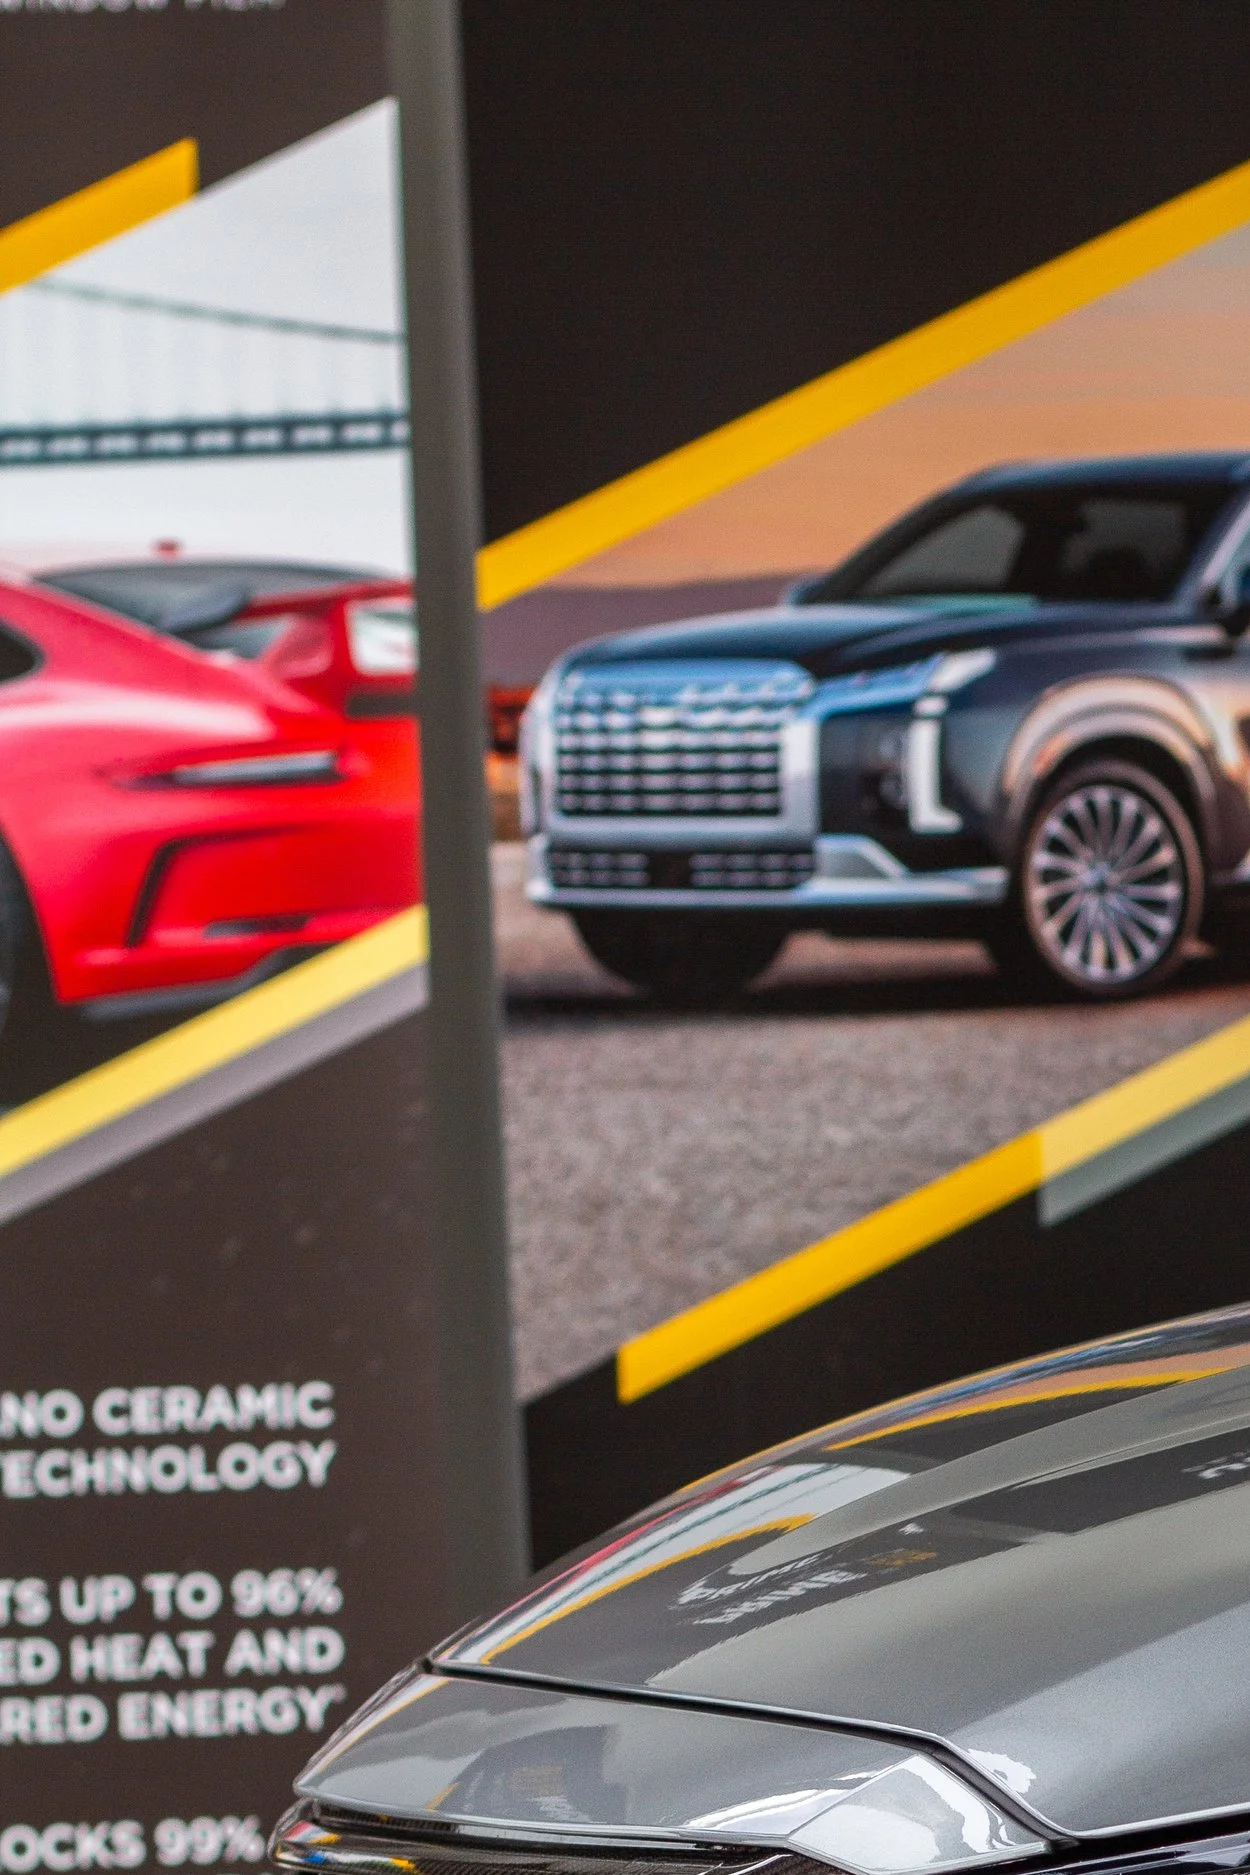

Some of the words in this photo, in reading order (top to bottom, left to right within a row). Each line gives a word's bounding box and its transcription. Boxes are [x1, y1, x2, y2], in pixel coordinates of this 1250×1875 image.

[92, 1380, 335, 1436] CERAMIC
[0, 1439, 337, 1498] ECHNOLOGY
[59, 1574, 136, 1624] UP
[142, 1570, 222, 1621] TO
[231, 1567, 343, 1618] 96%
[69, 1630, 215, 1683] HEAT
[223, 1625, 344, 1677] AND
[154, 1815, 265, 1866] 99%
